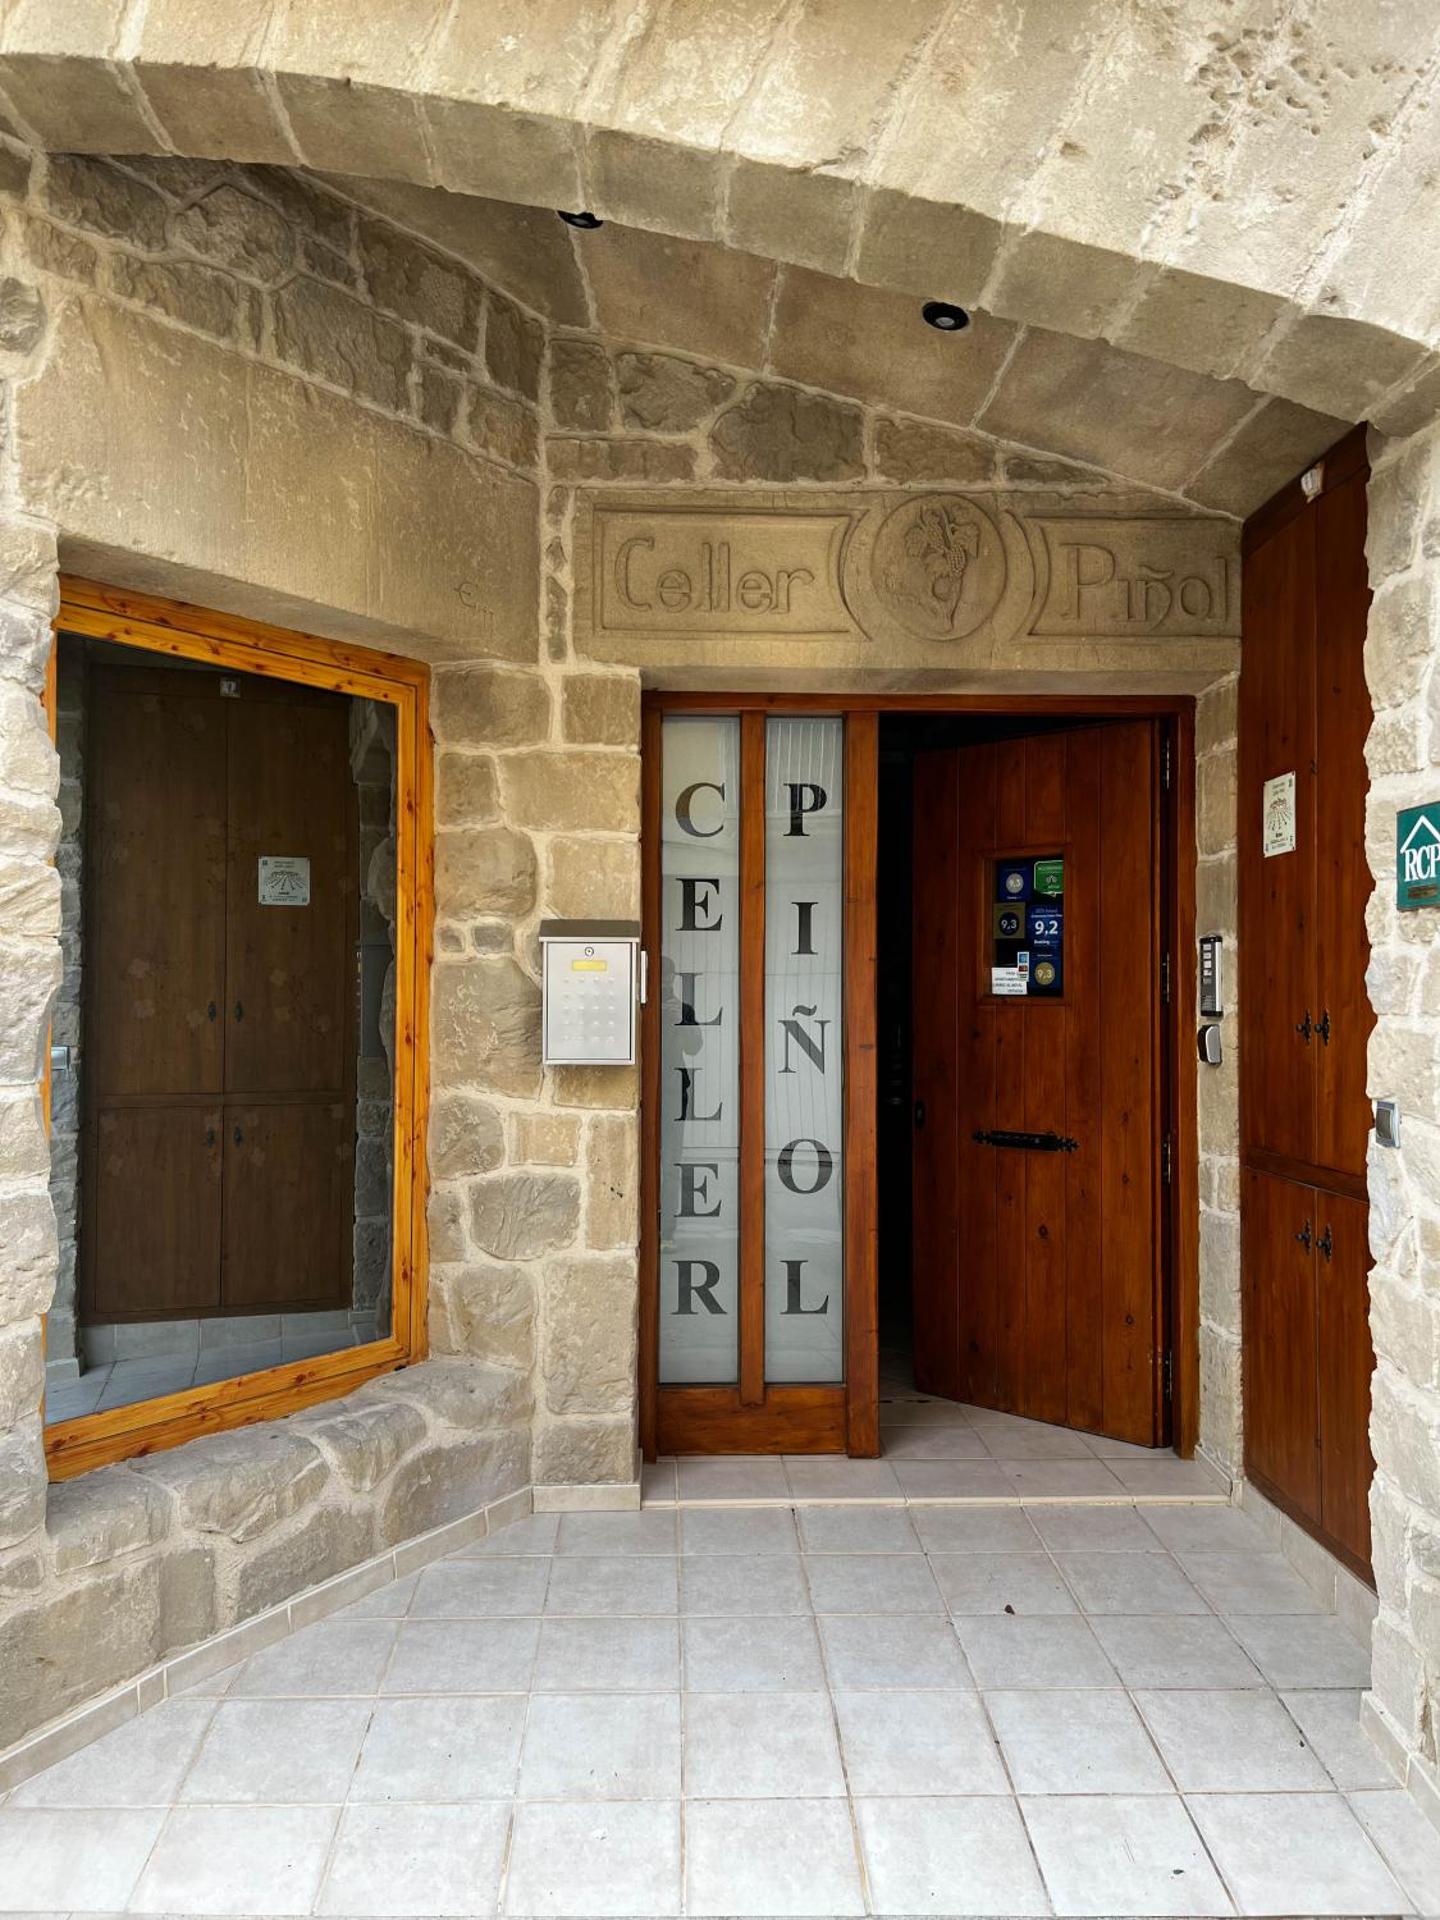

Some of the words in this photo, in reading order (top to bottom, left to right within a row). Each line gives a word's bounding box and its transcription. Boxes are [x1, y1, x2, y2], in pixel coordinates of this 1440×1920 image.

[614, 536, 815, 616] Celler
[1064, 541, 1231, 635] Piñol
[1001, 919, 1017, 930] 9,3
[1034, 920, 1058, 935] 9,2
[673, 781, 727, 1315] CELLER
[777, 782, 833, 1315] PIÑOL
